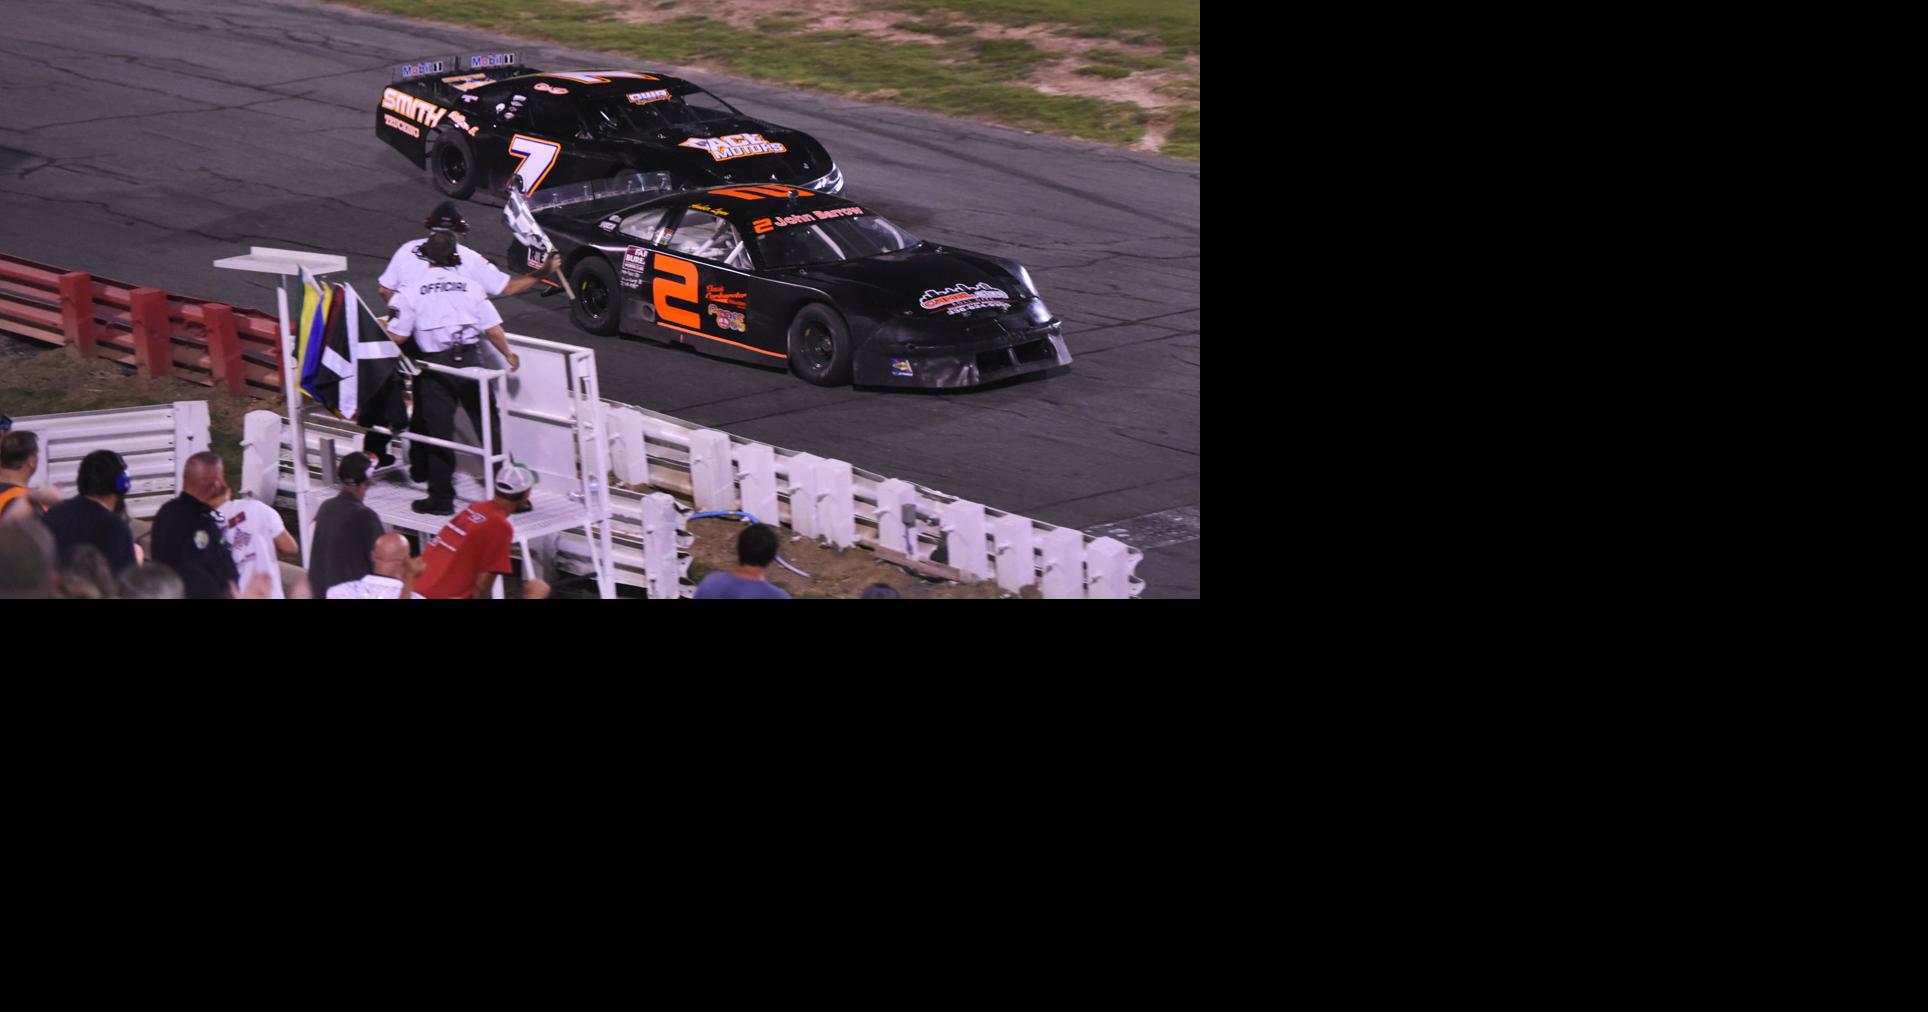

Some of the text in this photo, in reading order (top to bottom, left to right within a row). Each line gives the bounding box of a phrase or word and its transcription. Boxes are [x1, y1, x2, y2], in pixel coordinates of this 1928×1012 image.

[402, 62, 433, 77] Mobil
[472, 54, 503, 67] Mobil
[382, 87, 448, 128] SMITH
[715, 142, 787, 160] MOTORS
[506, 133, 561, 197] 7
[752, 207, 864, 234] 2 John Barrow
[420, 281, 469, 295] OFFICIAL
[653, 253, 701, 329] 2
